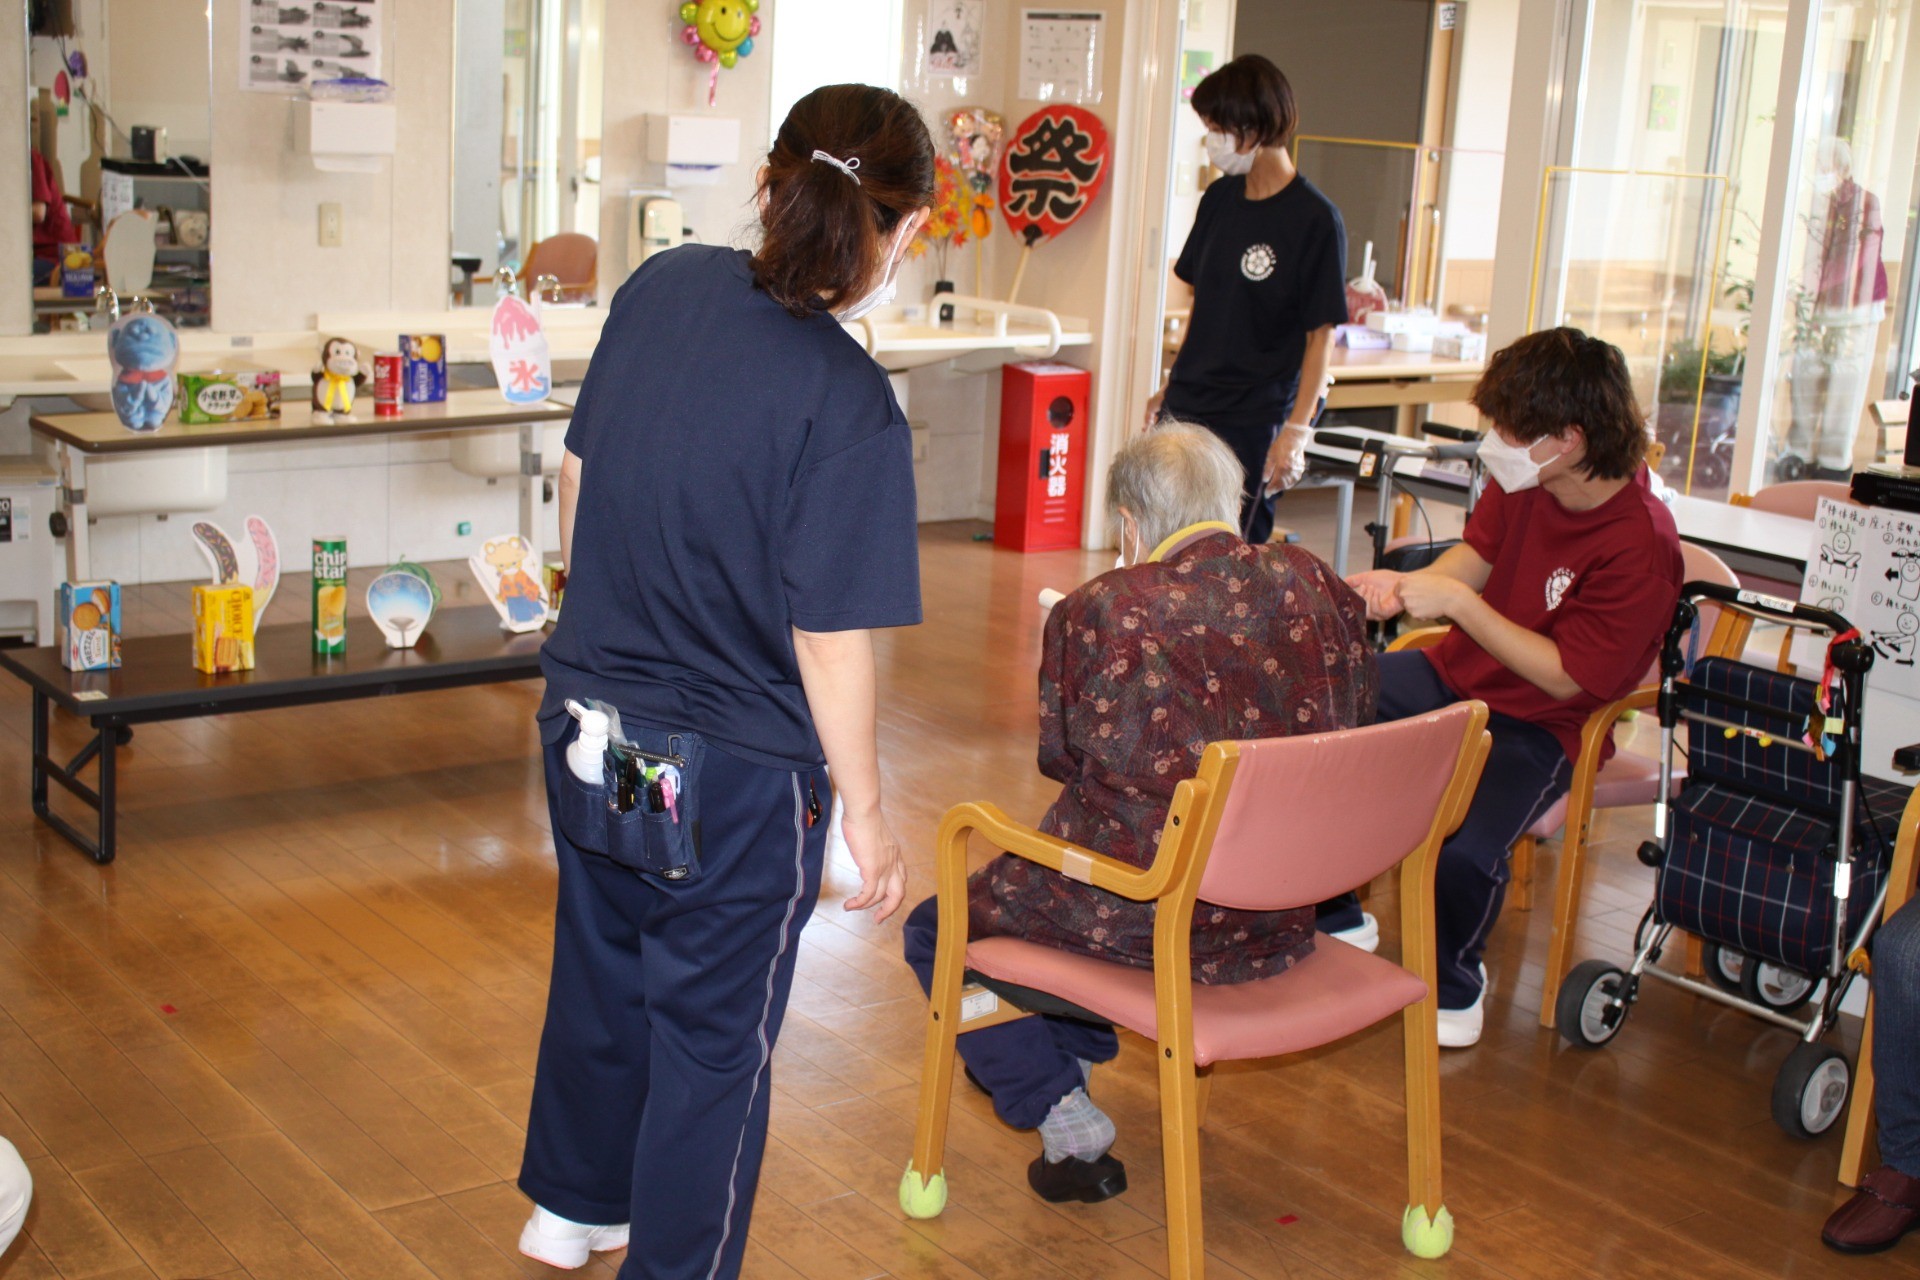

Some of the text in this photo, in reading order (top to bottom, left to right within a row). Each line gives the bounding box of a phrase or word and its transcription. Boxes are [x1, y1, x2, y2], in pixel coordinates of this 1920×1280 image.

[1006, 116, 1103, 222] 祭
[509, 360, 543, 391] 氷
[1047, 433, 1070, 498] 消火器
[315, 549, 347, 566] chip
[315, 564, 347, 579] star
